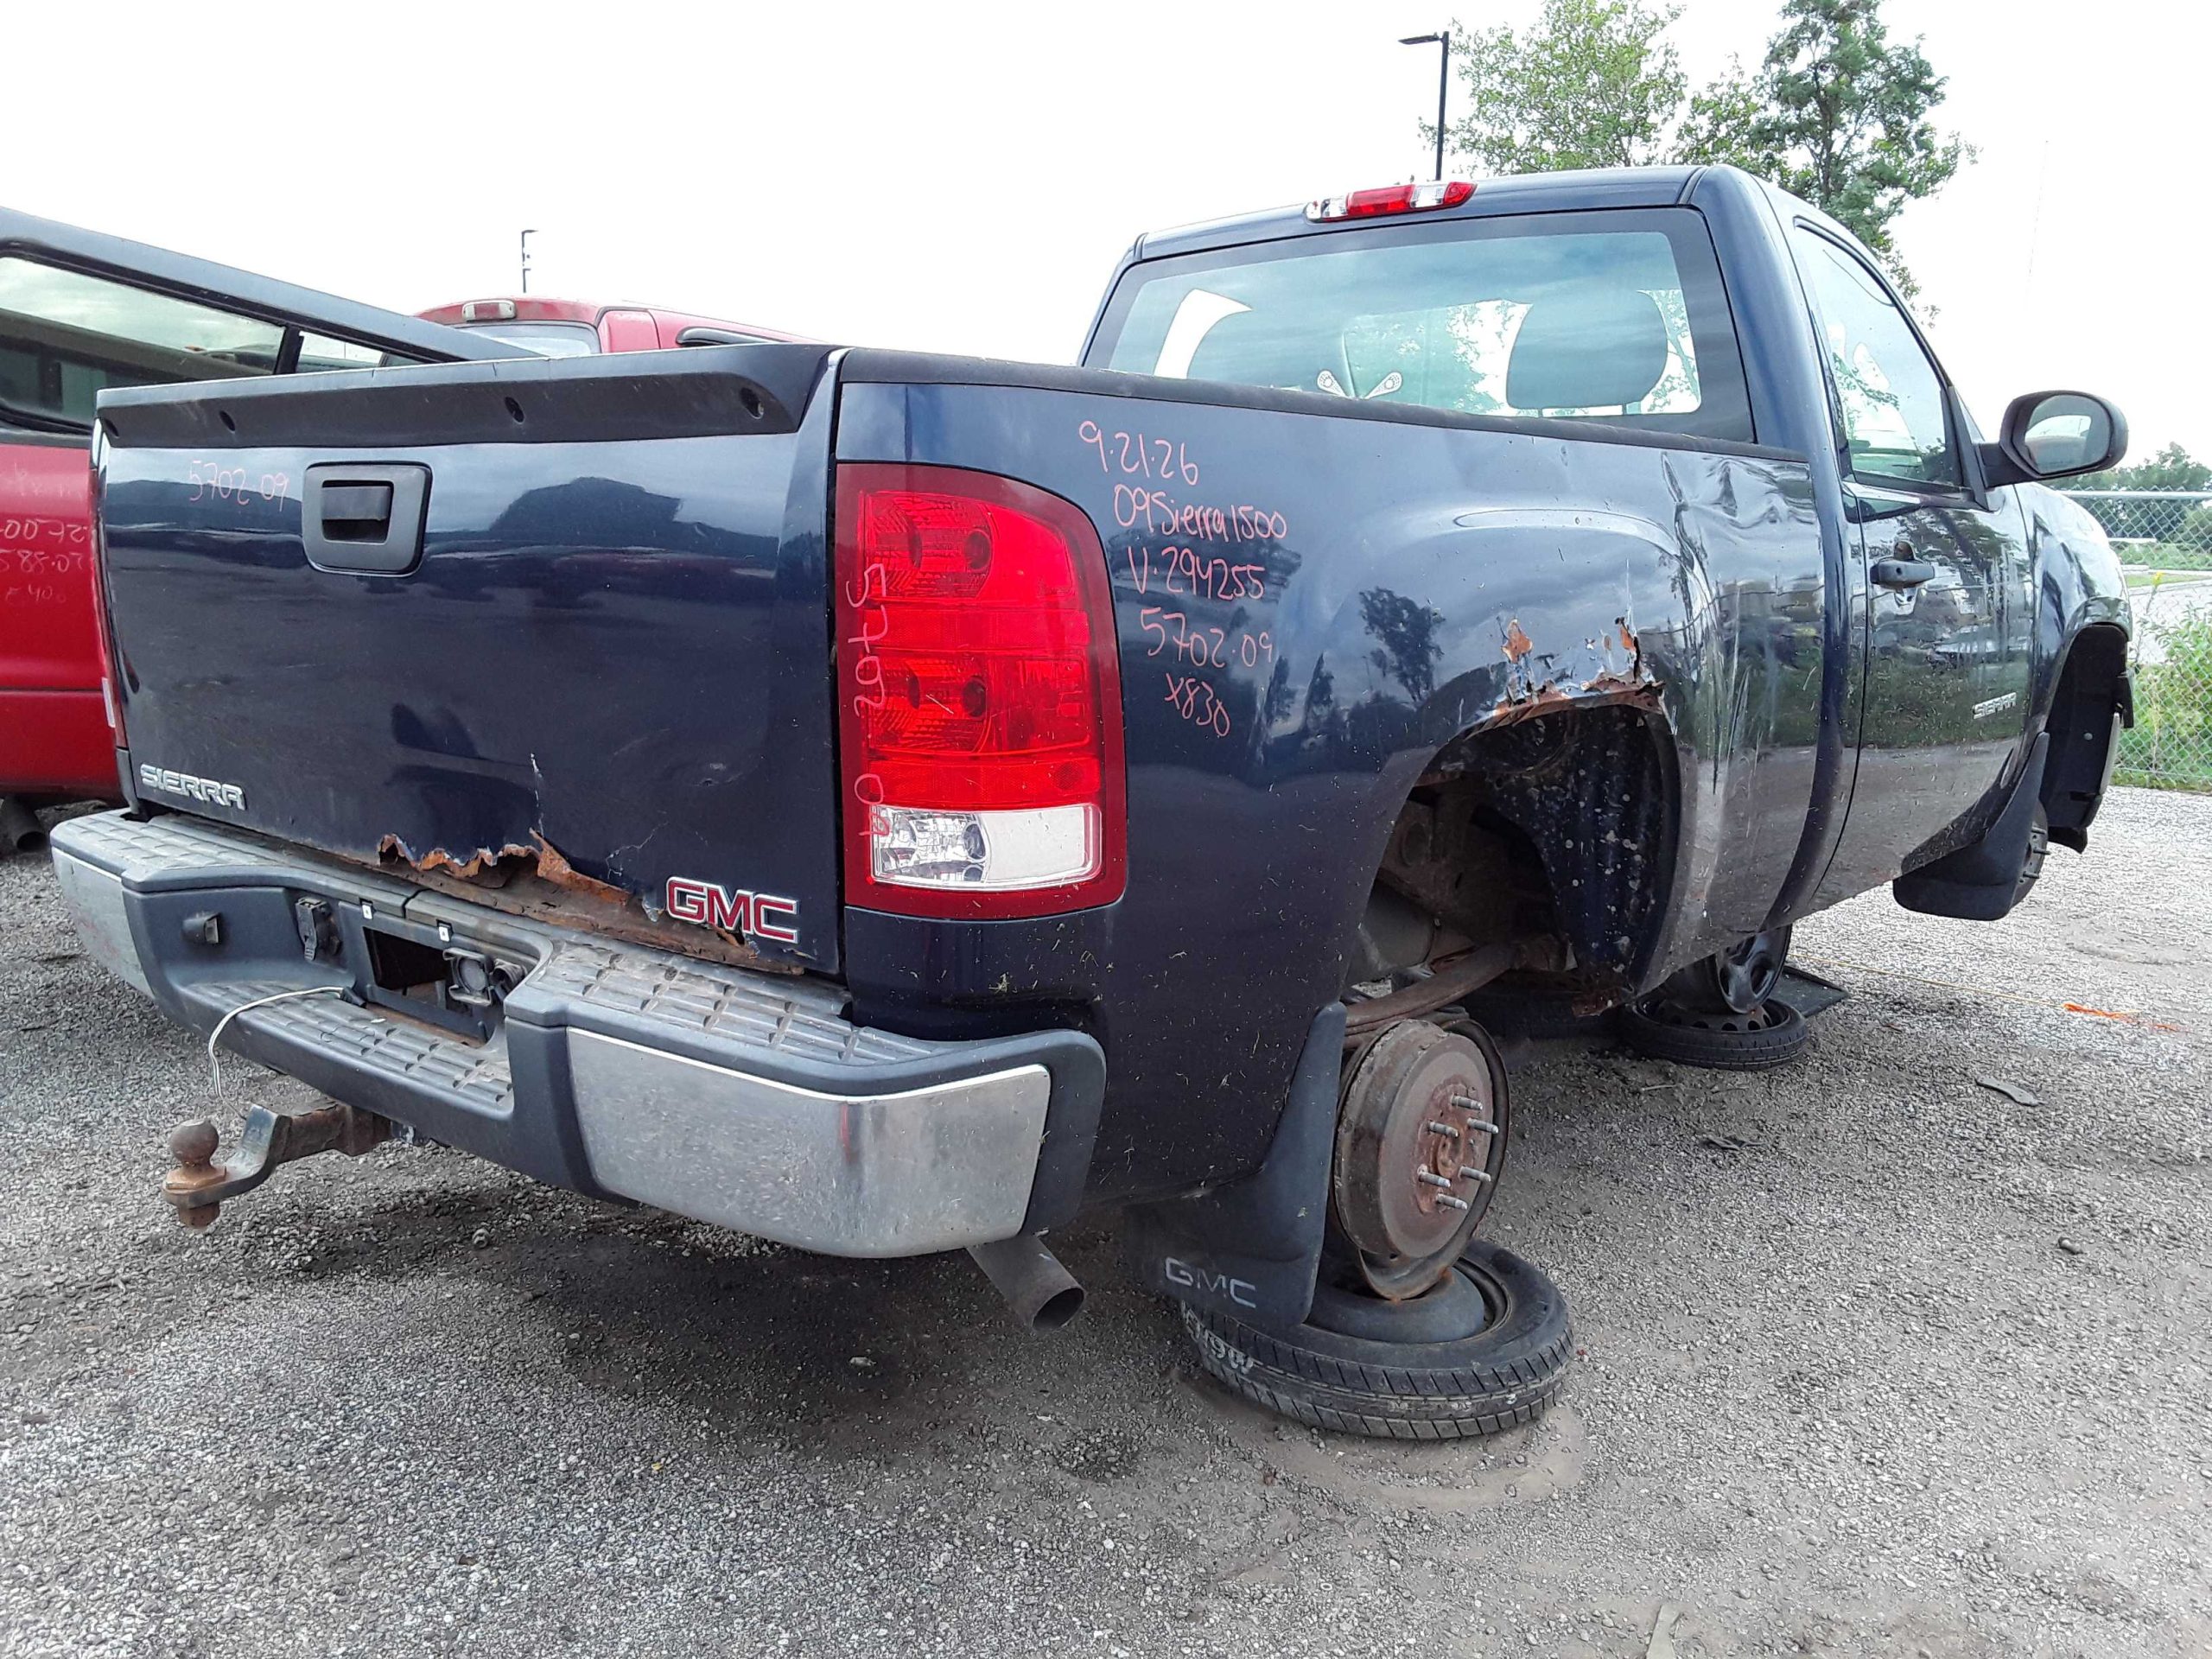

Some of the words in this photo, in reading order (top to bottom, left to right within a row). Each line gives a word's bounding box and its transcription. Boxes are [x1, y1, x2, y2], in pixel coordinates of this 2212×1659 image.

[1972, 691, 2017, 720] SIERRA
[140, 764, 246, 811] SIERRA
[666, 876, 799, 944] GMC
[1166, 1256, 1256, 1309] GMC
